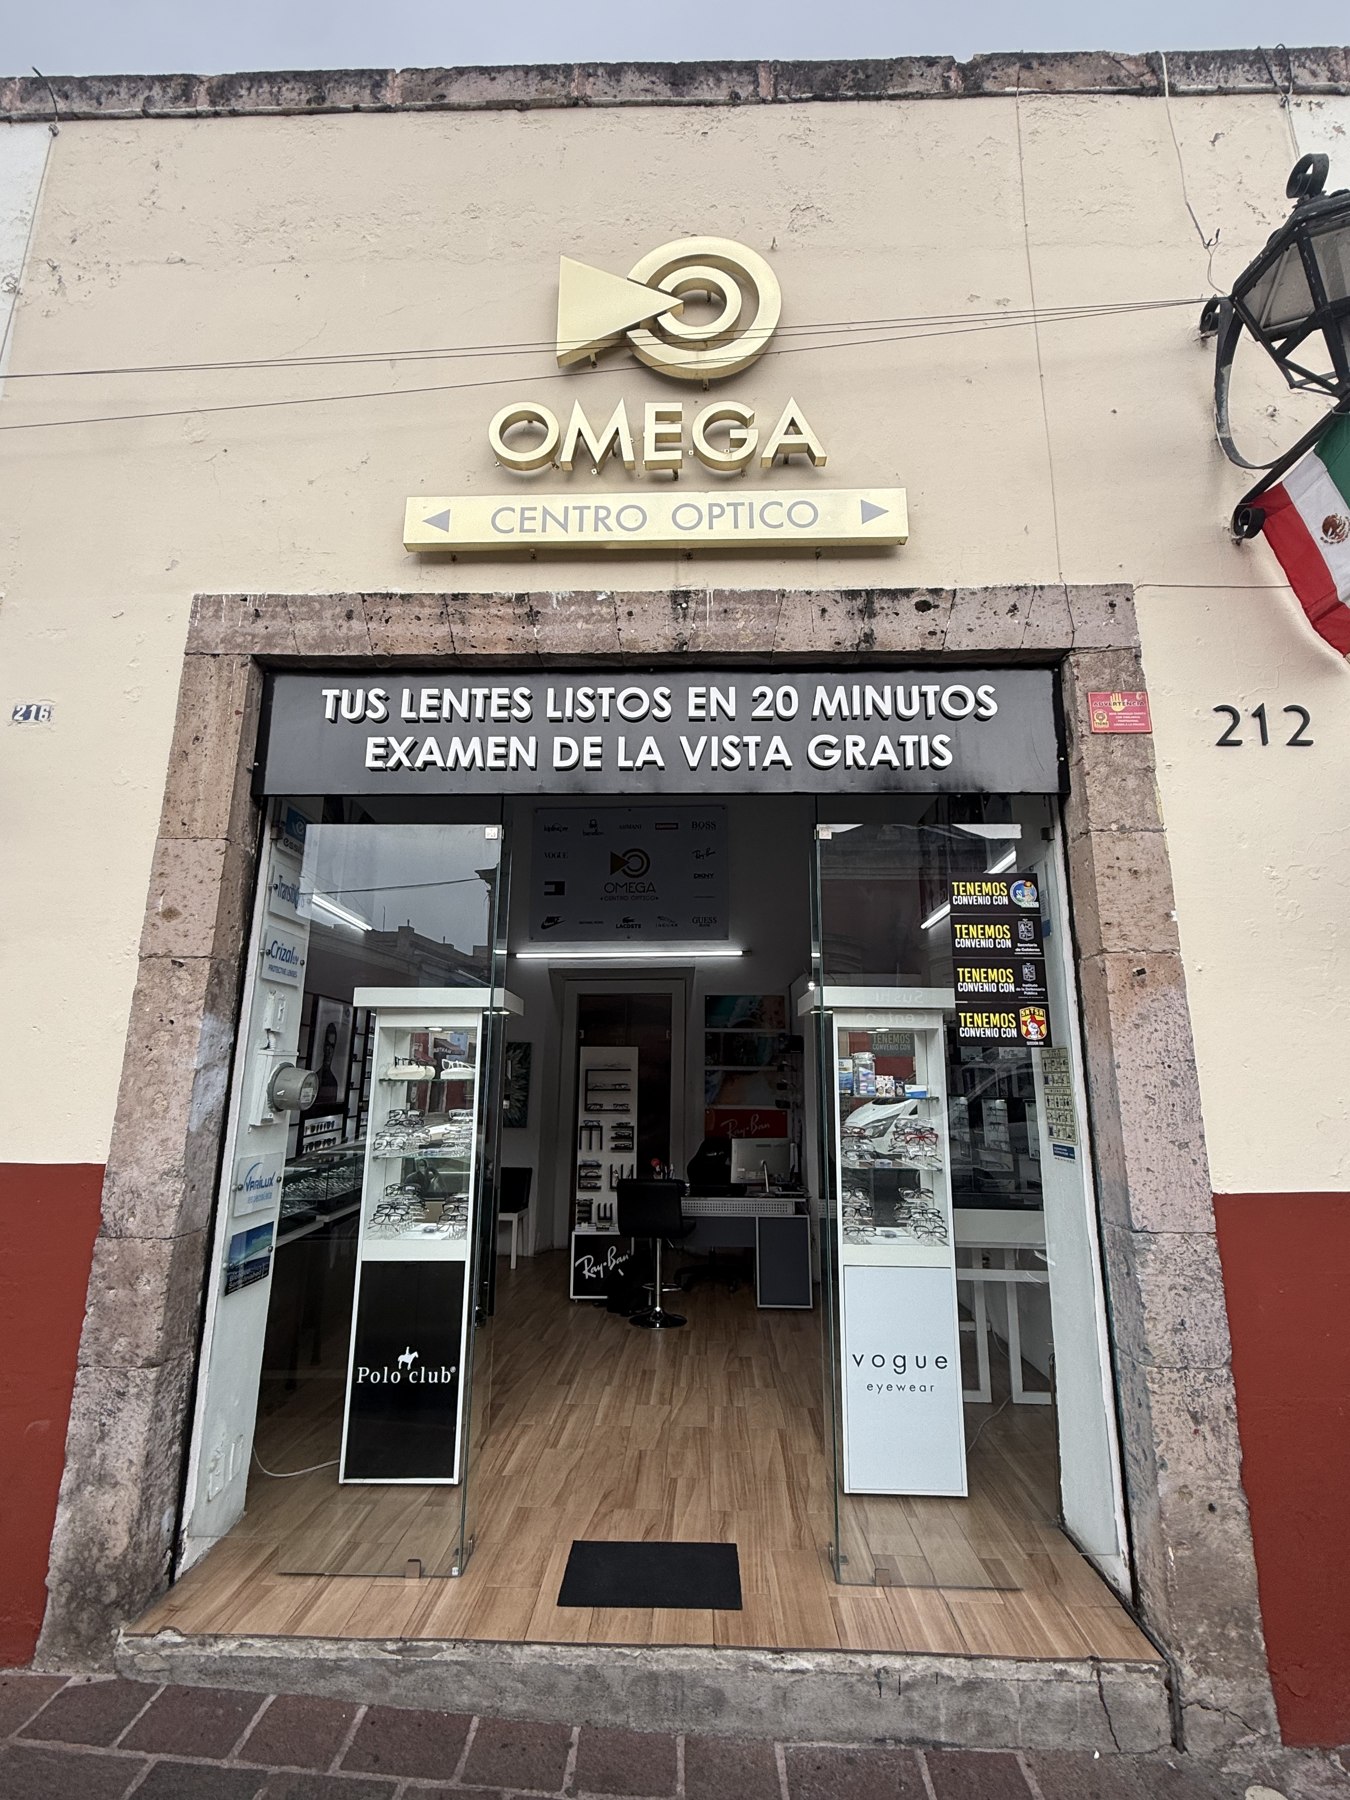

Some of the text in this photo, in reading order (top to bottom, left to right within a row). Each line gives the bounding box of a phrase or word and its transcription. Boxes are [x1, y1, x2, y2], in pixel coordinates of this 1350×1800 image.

[487, 396, 828, 472] OMEGA
[490, 499, 820, 534] CENTRO OPTICO
[321, 684, 999, 721] TUS LENTES LISTOS EN 20 MINUTOS
[13, 704, 50, 722] 216
[1213, 703, 1314, 746] 212
[364, 734, 955, 772] EXAMEN DE LA VISTA GRATIS
[603, 881, 657, 894] OMEGA
[951, 881, 1008, 897] TENEMOS
[952, 896, 1009, 906] CONVENIO CON
[954, 924, 1012, 939] TENEMOS
[955, 938, 1012, 949] CONVENIO CON
[270, 940, 295, 965] Crizal
[957, 967, 1014, 983] TENEMOS
[957, 982, 1016, 993] CONVENIO CON
[958, 1012, 1017, 1028] TENEMOS
[959, 1027, 1018, 1038] CONVENIO CON
[245, 1171, 276, 1192] VARILUX
[852, 1353, 948, 1375] vogue
[356, 1367, 401, 1384] Polo
[866, 1383, 935, 1395] eyewear
